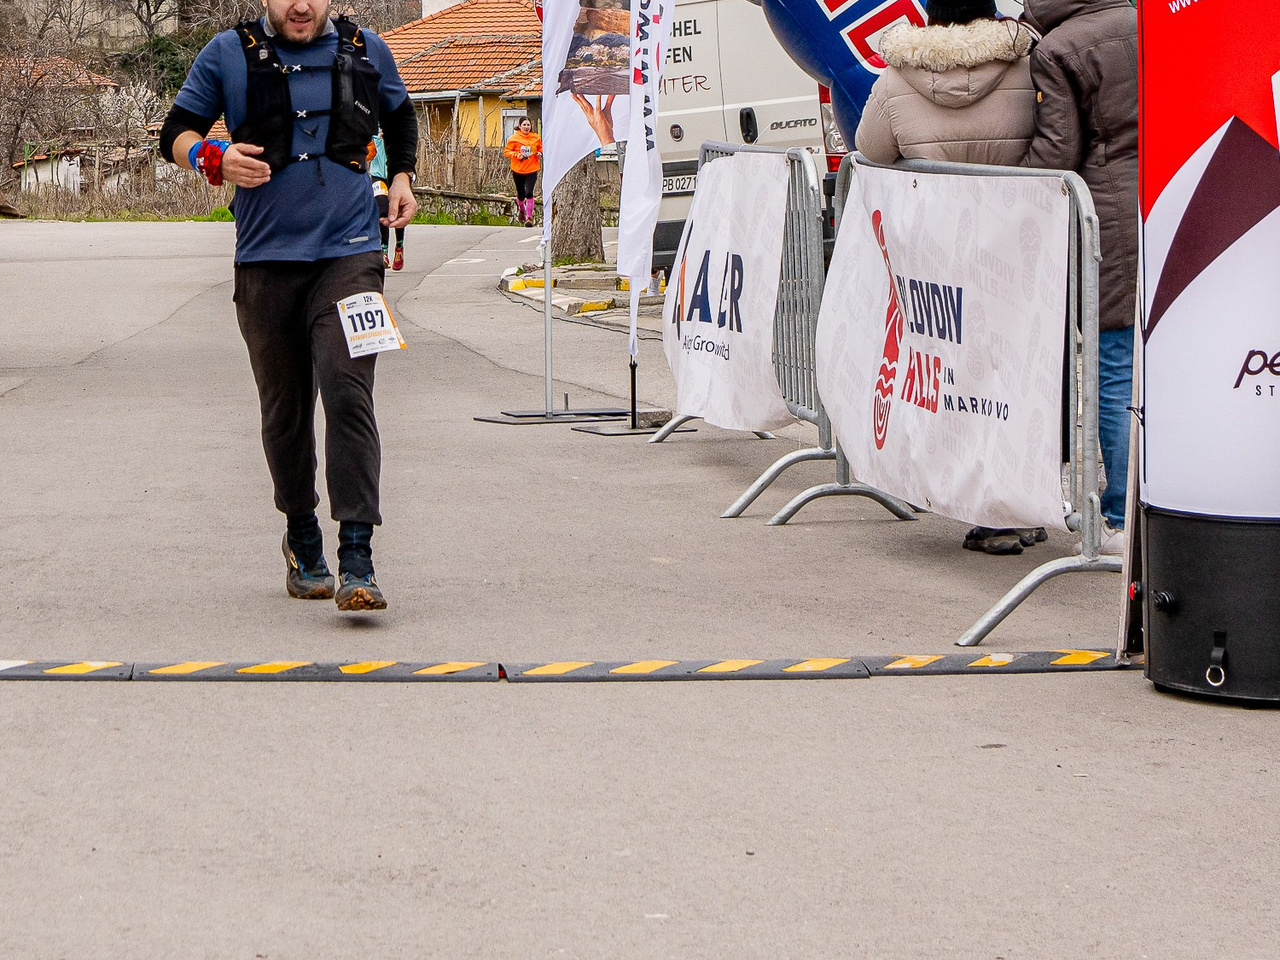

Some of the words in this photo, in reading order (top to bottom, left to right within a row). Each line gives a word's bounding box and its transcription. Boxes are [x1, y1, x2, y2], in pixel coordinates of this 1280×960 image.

[669, 19, 702, 38] HEL
[770, 118, 818, 130] DUCATO
[348, 309, 384, 333] 1197
[943, 367, 955, 386] IN
[944, 393, 1009, 421] MARKOVO
